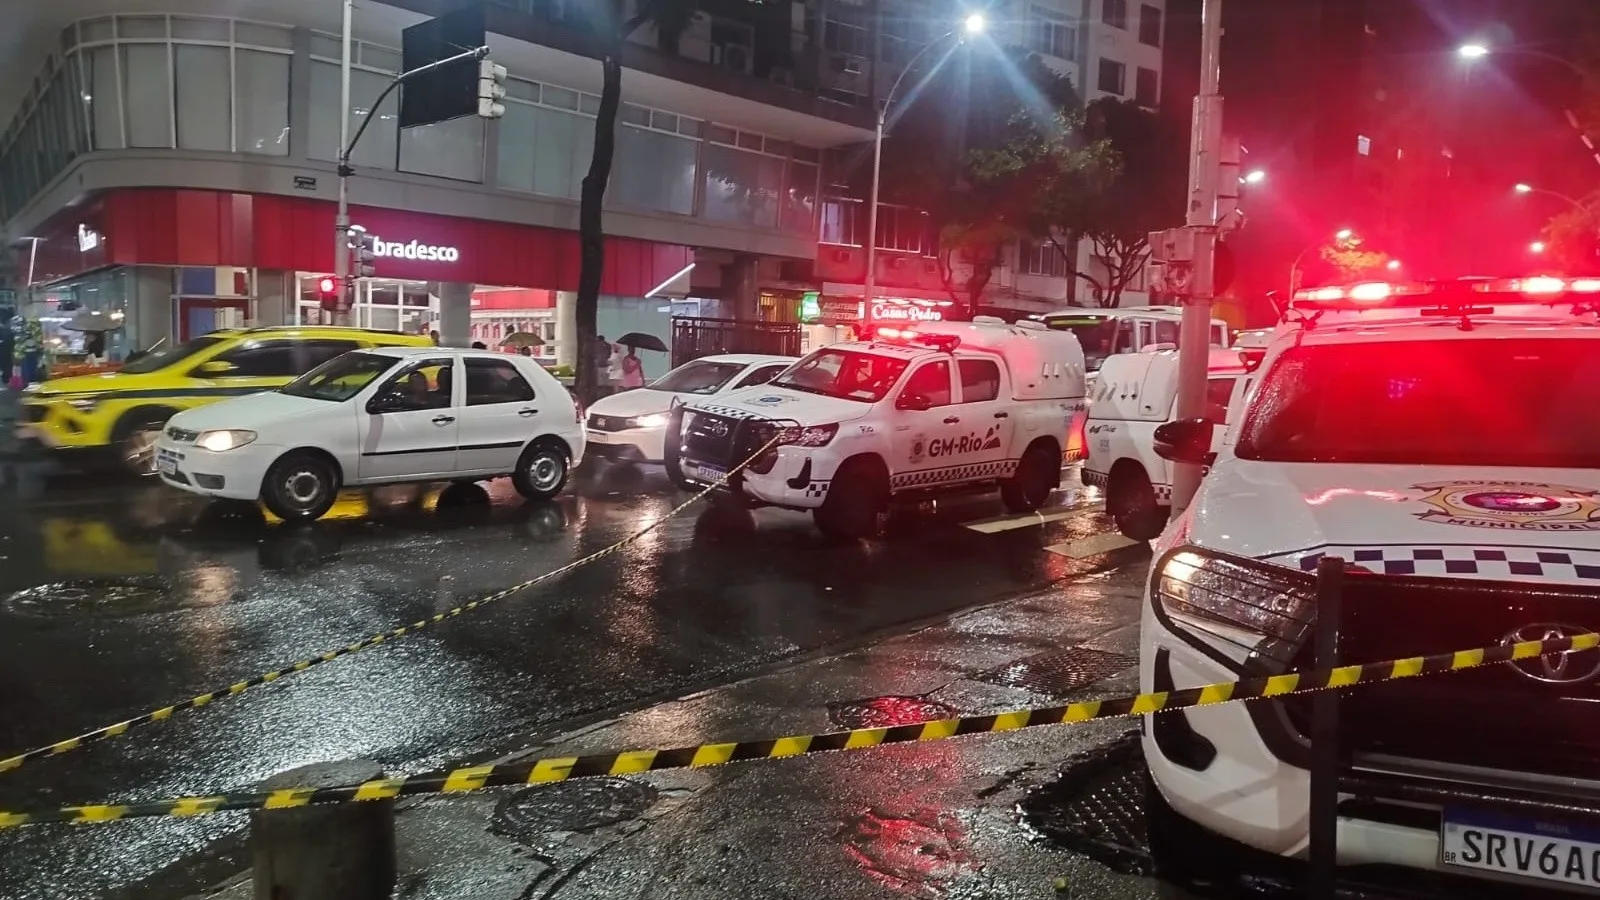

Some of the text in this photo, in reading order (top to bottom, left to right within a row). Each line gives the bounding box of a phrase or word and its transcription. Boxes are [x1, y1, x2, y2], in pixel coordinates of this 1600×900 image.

[373, 236, 459, 262] bradesco
[872, 304, 942, 321] Casas Pedro
[929, 432, 983, 457] GM-Rio
[1453, 480, 1549, 488] GUARDA
[1447, 518, 1600, 531] MUNICIPAL
[1445, 851, 1457, 863] BR
